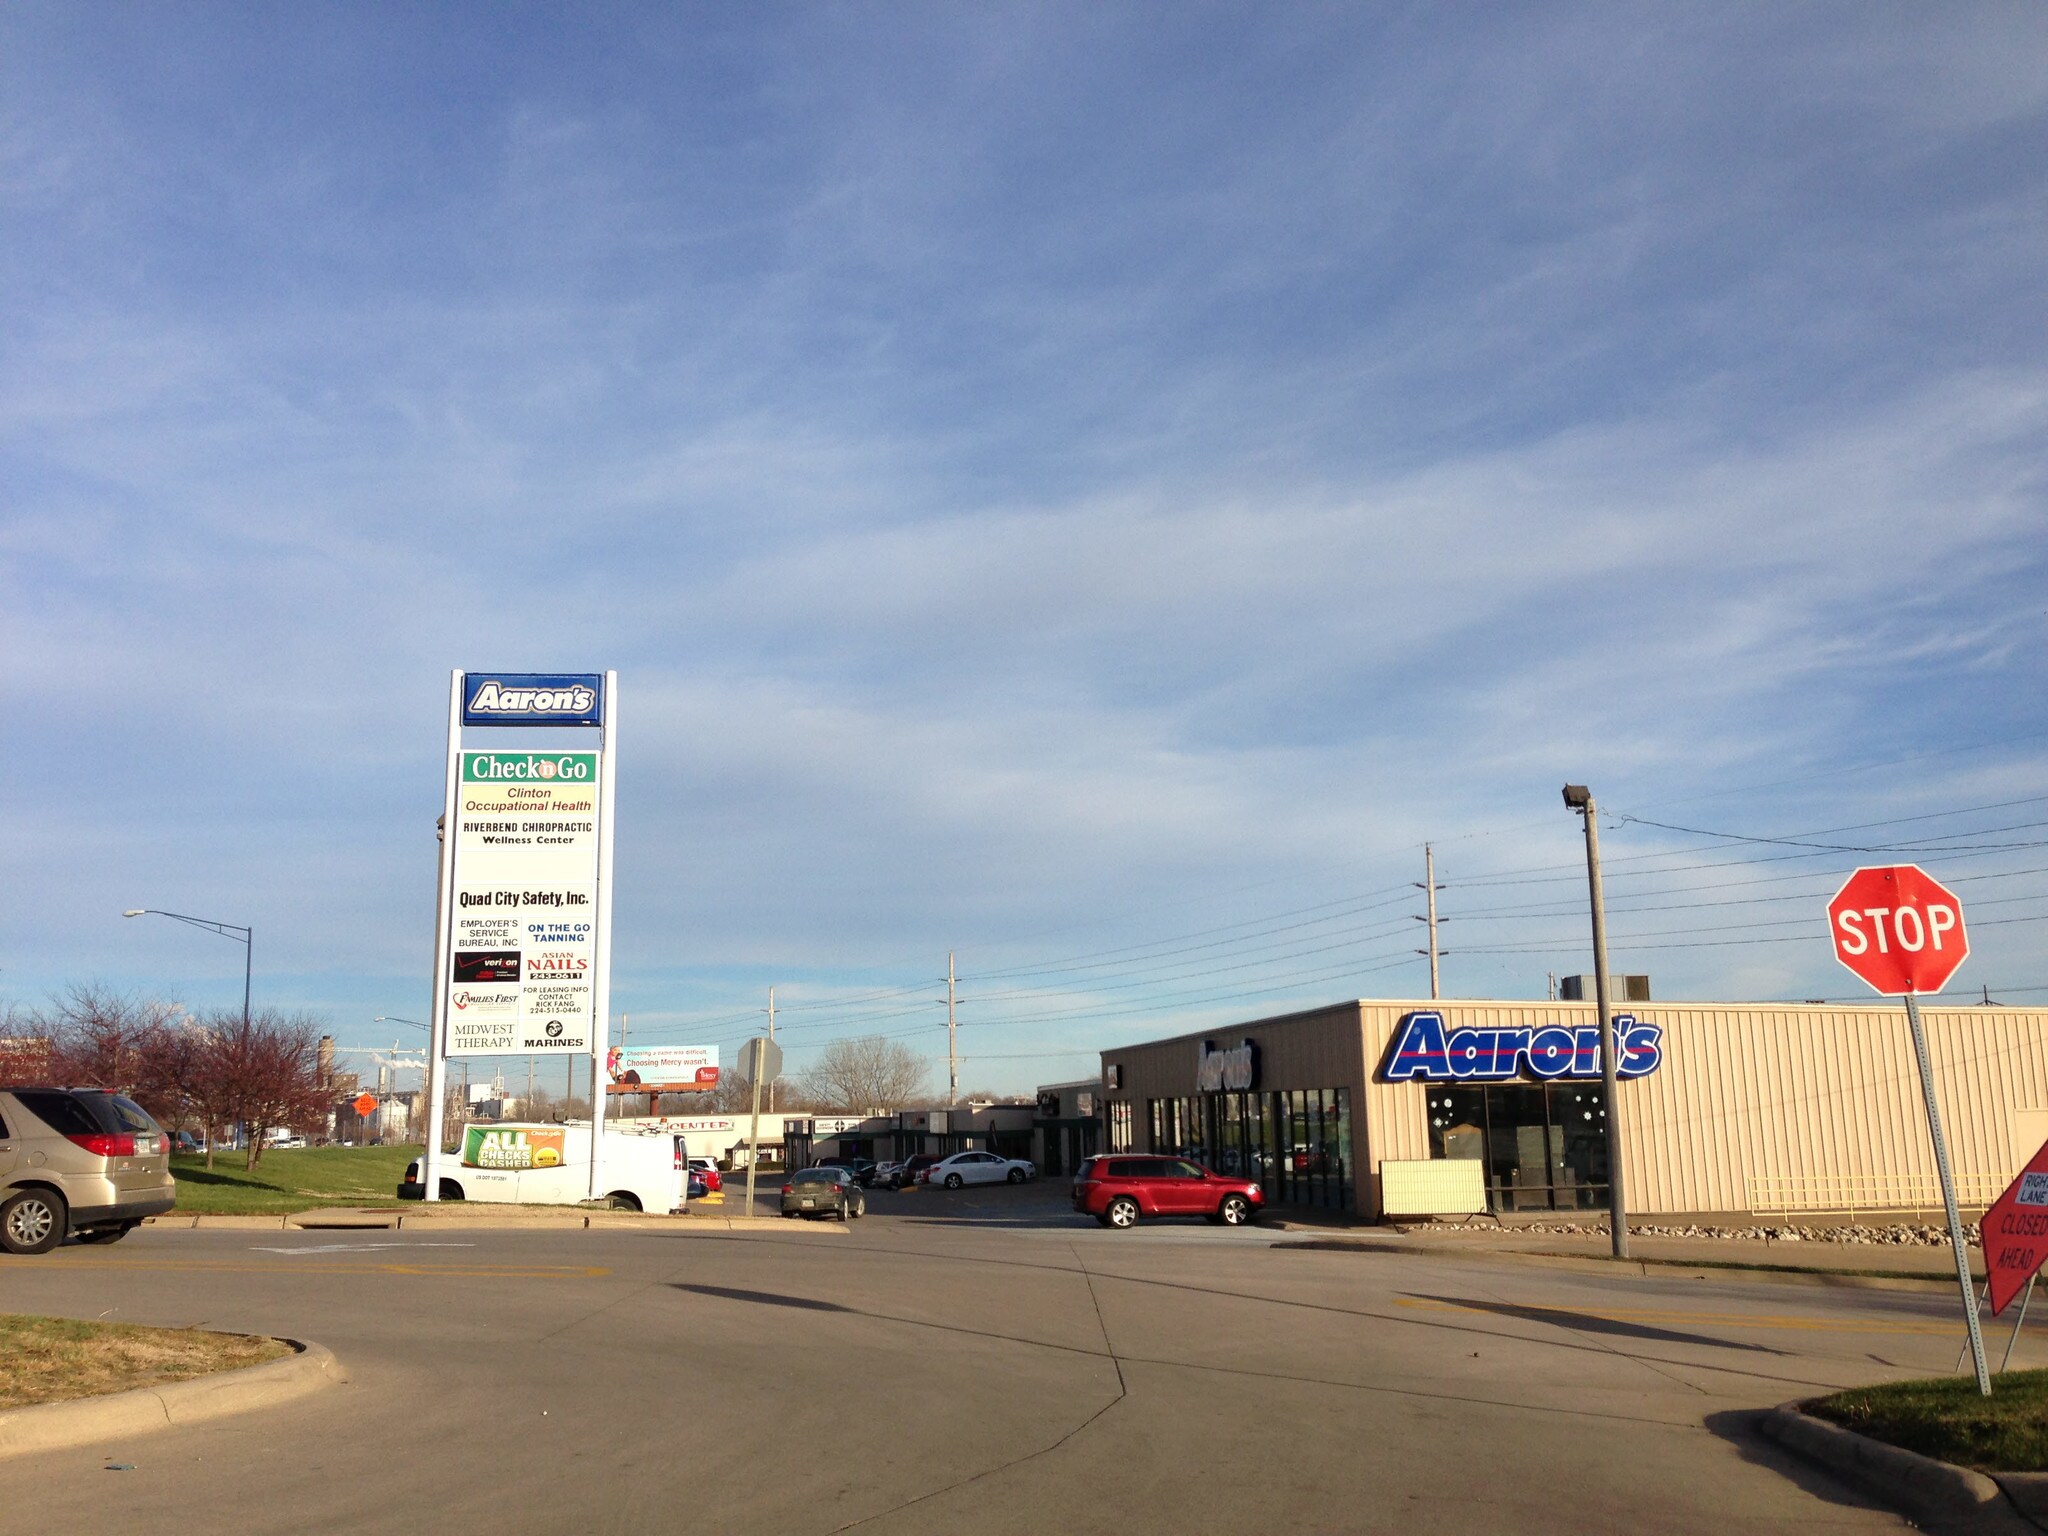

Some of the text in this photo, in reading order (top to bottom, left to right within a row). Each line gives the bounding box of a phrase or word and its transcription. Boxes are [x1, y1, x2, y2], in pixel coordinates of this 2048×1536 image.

[470, 682, 594, 713] Aaron's
[472, 755, 540, 779] Check
[557, 756, 587, 779] Go
[507, 788, 551, 798] Clinton
[465, 800, 591, 813] Occupational Health
[463, 822, 592, 832] RIVERBEND CHIROPRACTIC
[482, 836, 575, 844] Wellness Center
[459, 891, 589, 908] Quad City Safety, Inc.
[460, 919, 518, 928] EMPLOYER'S
[528, 923, 590, 932] ON THE GO
[469, 929, 509, 937] SERVICE
[1838, 904, 1956, 956] STOP
[458, 938, 518, 947] BUREAU, INC
[533, 933, 585, 942] TANNING
[484, 958, 518, 967] verizon
[527, 959, 588, 970] NAILS
[455, 1023, 515, 1035] MIDWEST
[454, 1037, 514, 1048] THERAPY
[524, 1038, 583, 1047] MARINES
[1382, 1010, 1663, 1081] Aaron's
[626, 1059, 659, 1067] Choosing
[481, 1131, 531, 1150] ALL
[480, 1150, 530, 1159] CHECKS
[480, 1159, 530, 1168] CASHED
[2024, 1174, 2048, 1188] RIGH
[2020, 1190, 2048, 1204] LANE
[2001, 1213, 2048, 1237] CLOSED
[1997, 1246, 2034, 1270] AHEAD
